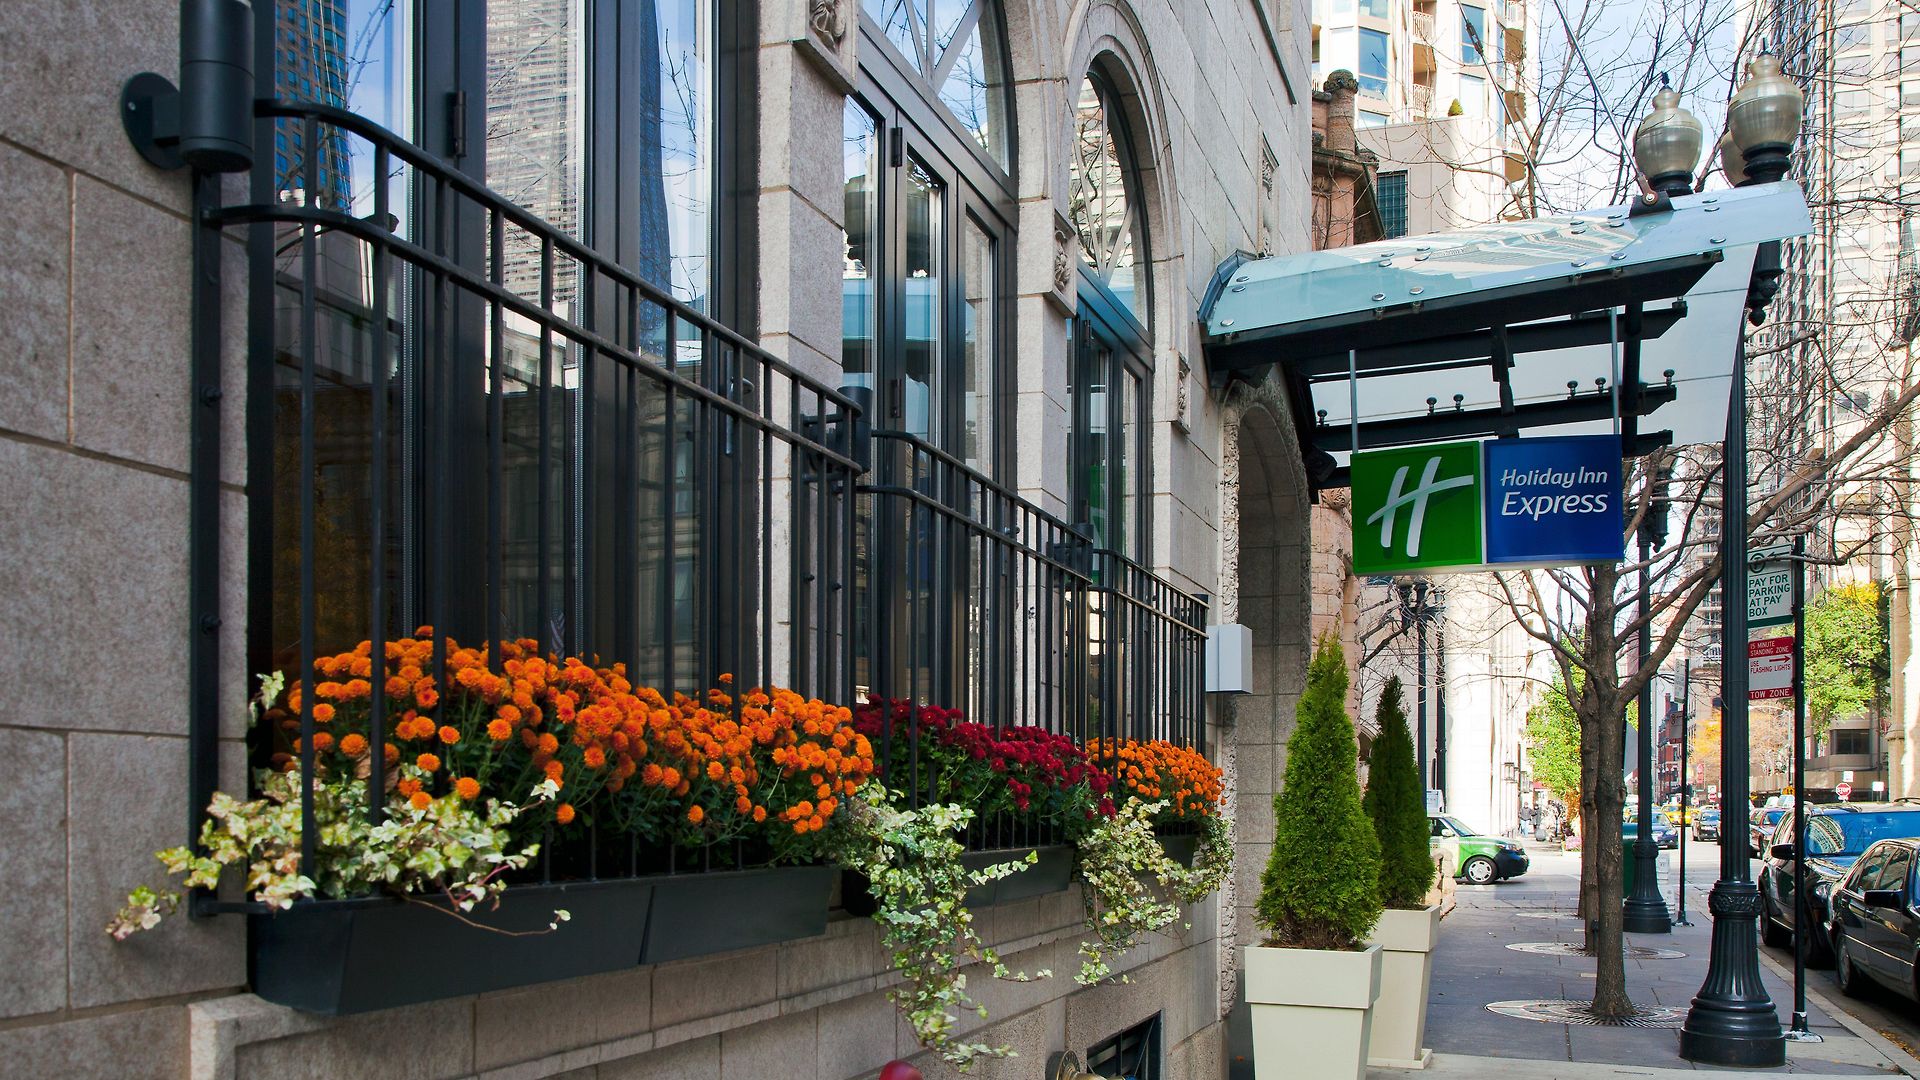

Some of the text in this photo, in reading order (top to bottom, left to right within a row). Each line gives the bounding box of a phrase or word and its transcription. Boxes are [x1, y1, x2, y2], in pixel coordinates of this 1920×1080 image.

[1500, 466, 1608, 488] Holiday Inn
[1501, 491, 1608, 521] Express
[1749, 574, 1788, 588] PAY FOR
[1749, 583, 1790, 598] PARKING
[1749, 595, 1781, 607] AT PAY
[1749, 607, 1768, 618] BOX
[1750, 646, 1789, 657] STANDING ZONE
[1750, 688, 1790, 699] TOW ZONE
